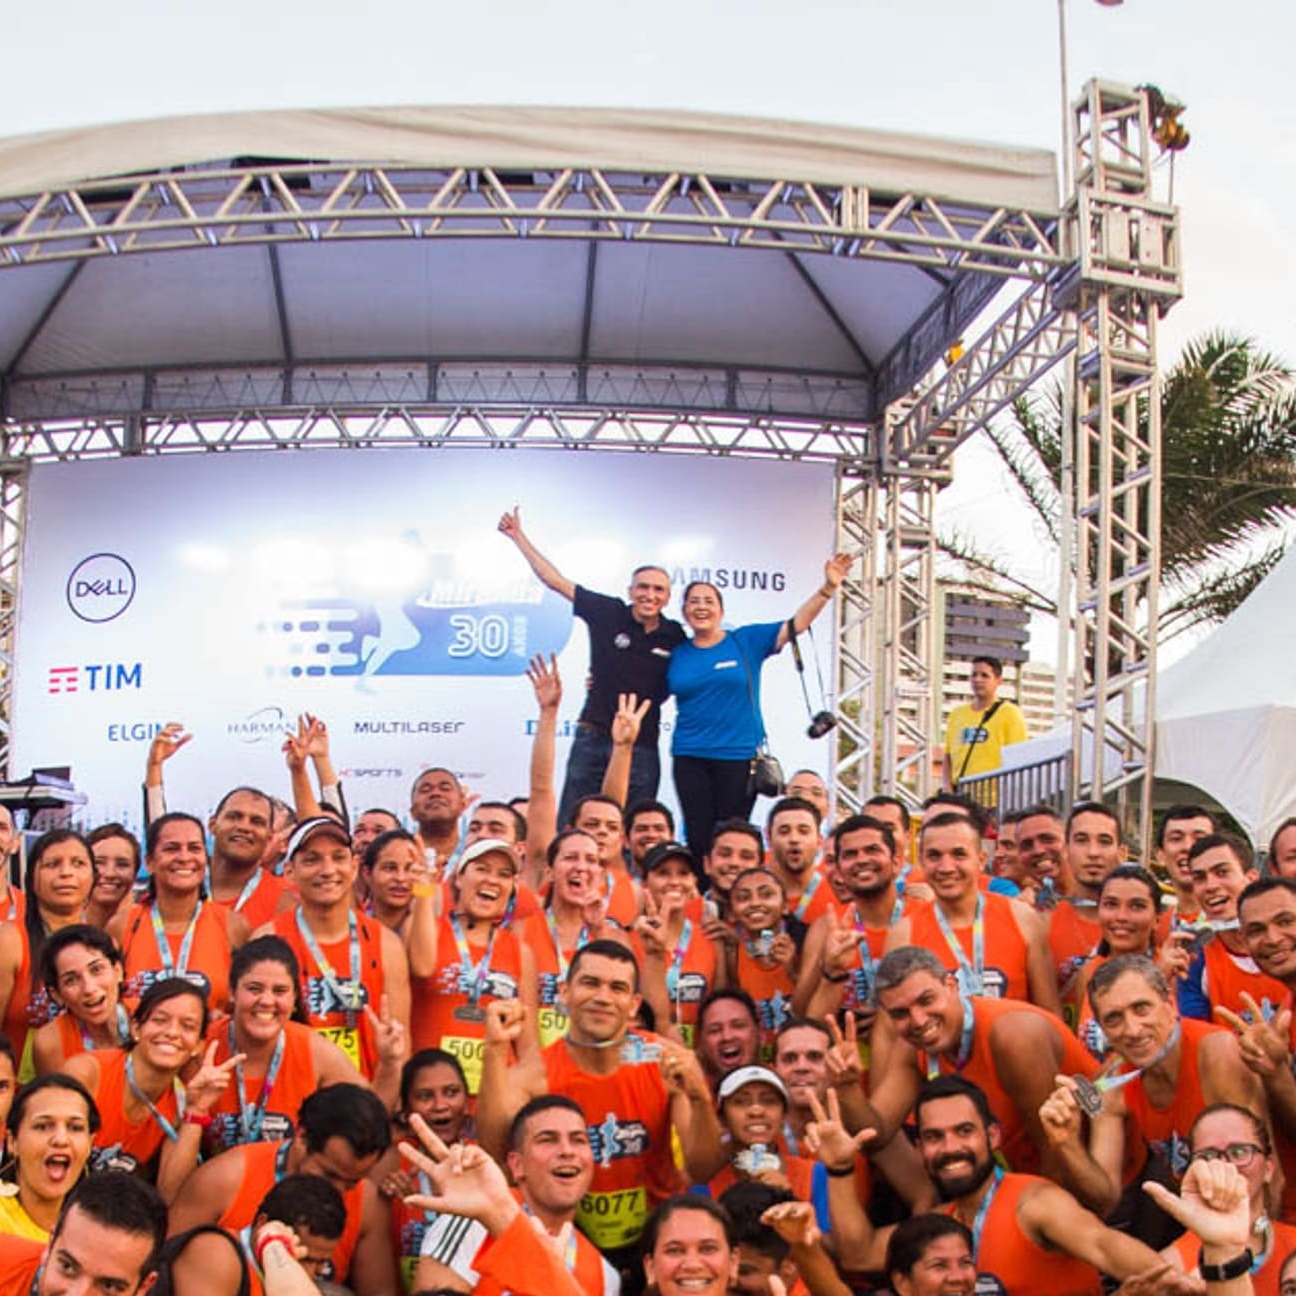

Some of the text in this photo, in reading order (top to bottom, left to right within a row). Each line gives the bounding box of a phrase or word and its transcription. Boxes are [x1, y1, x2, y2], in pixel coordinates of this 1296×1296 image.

[75, 578, 128, 598] DELL
[671, 568, 786, 592] AMSUNG
[448, 614, 509, 658] 30
[84, 662, 143, 691] TIM
[226, 721, 297, 734] HARMAN
[582, 1191, 639, 1216] 6077
